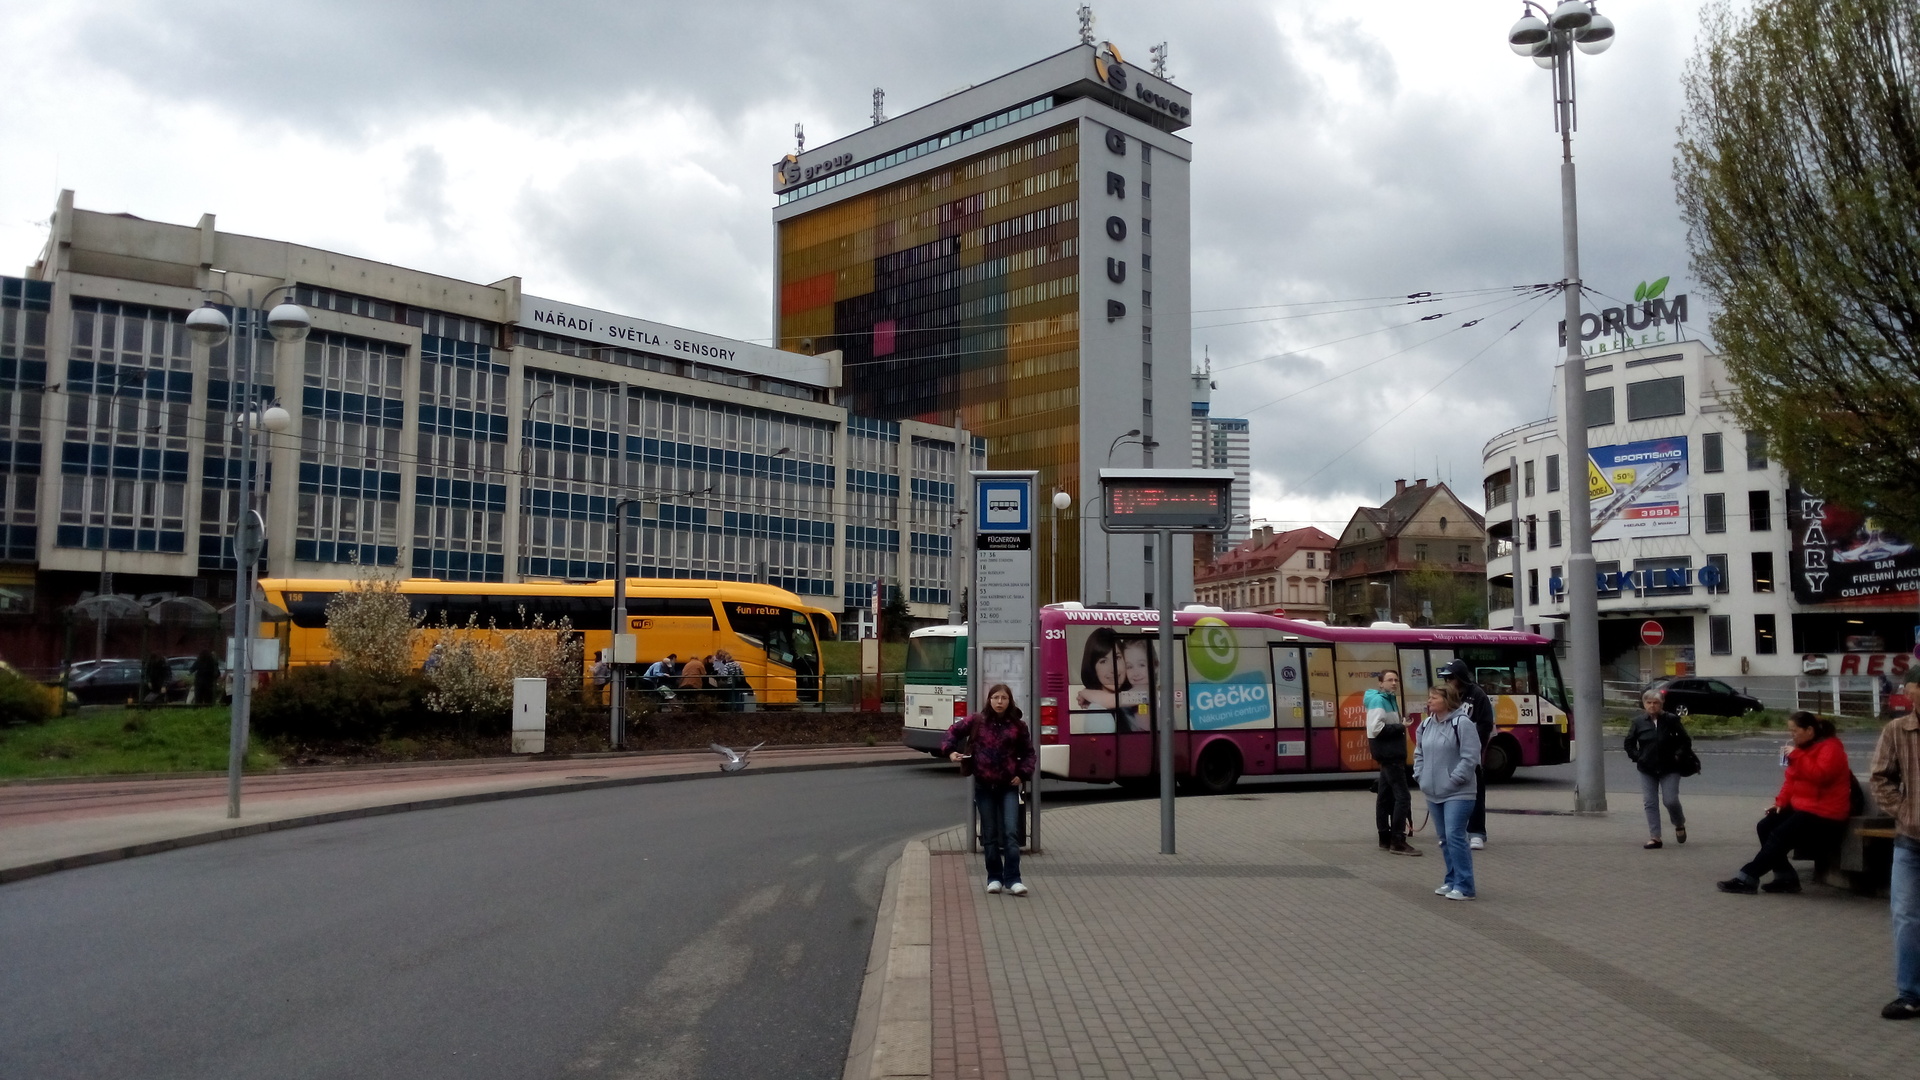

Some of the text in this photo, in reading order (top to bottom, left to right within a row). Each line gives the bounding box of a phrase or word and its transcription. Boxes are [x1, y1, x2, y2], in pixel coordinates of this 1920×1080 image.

[1136, 82, 1190, 118] tower
[805, 153, 853, 179] group
[1106, 128, 1127, 323] GROUP
[534, 309, 736, 361] NÁŘADÍ SVĚTLA SENSORY
[1589, 331, 1666, 355] IBEREC
[1614, 450, 1682, 463] SPORTISIMO
[1648, 467, 1674, 488] HEAD
[1802, 486, 1829, 593] KÁRY
[1874, 560, 1896, 570] BAR
[1549, 565, 1720, 596] PRKING
[1852, 570, 1895, 584] FIREMNÍ
[288, 593, 303, 602] 156
[1841, 586, 1880, 598] OSLAVY
[736, 605, 780, 616] fun relax
[1064, 610, 1178, 625] www.ncgeckoz
[1045, 629, 1066, 640] 331
[957, 667, 968, 676] 32
[934, 686, 943, 695] 326
[1196, 684, 1265, 711] Géčko
[1198, 703, 1268, 724] Nákupní centrum
[1521, 708, 1534, 717] 331
